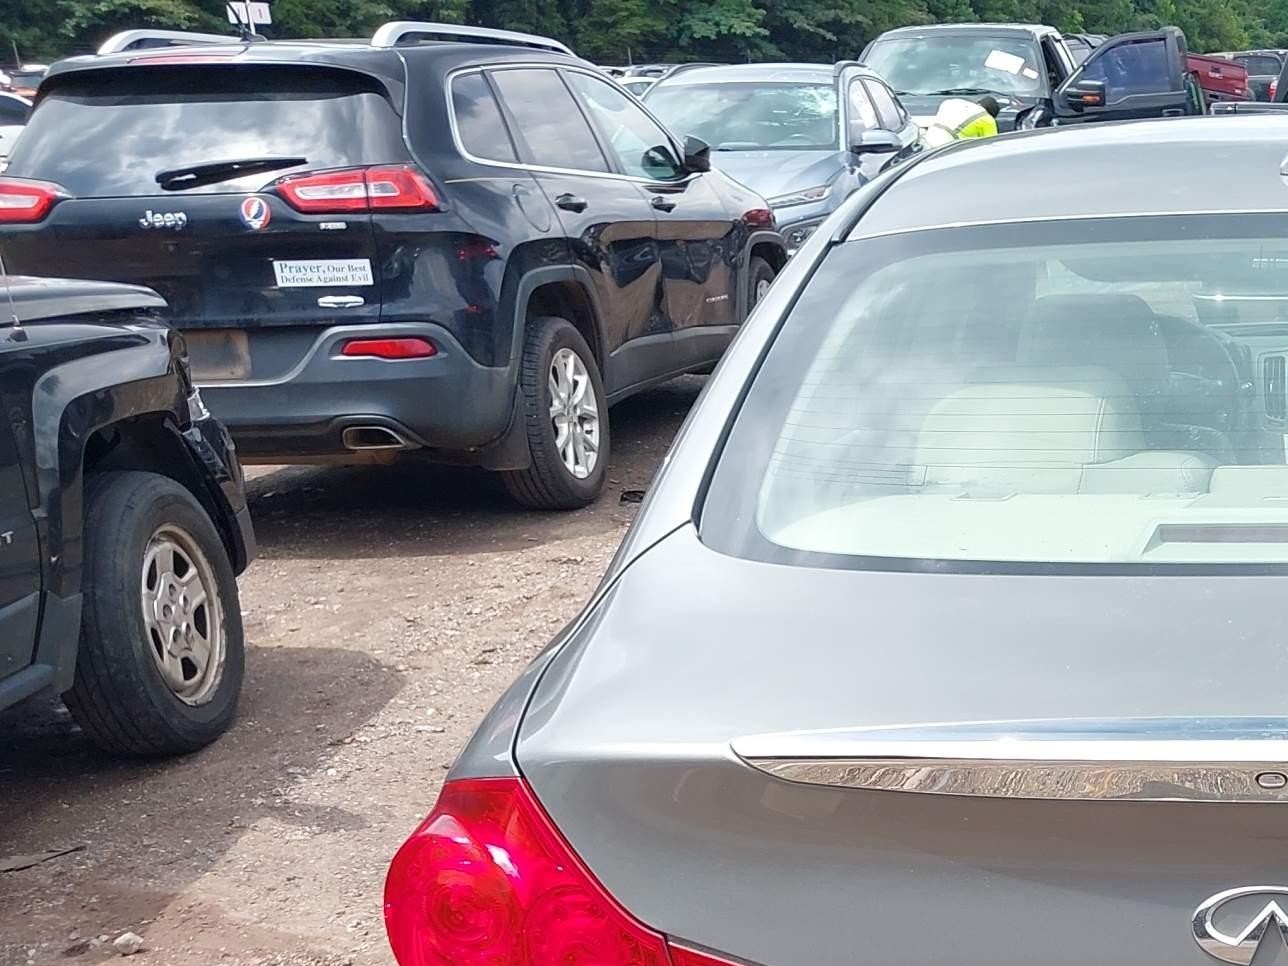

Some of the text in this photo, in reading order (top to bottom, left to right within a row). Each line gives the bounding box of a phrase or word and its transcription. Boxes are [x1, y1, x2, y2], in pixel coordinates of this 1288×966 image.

[139, 209, 188, 231] Jeep
[279, 262, 367, 276] Prayer, Our Best
[280, 273, 369, 284] Defense Against Evil
